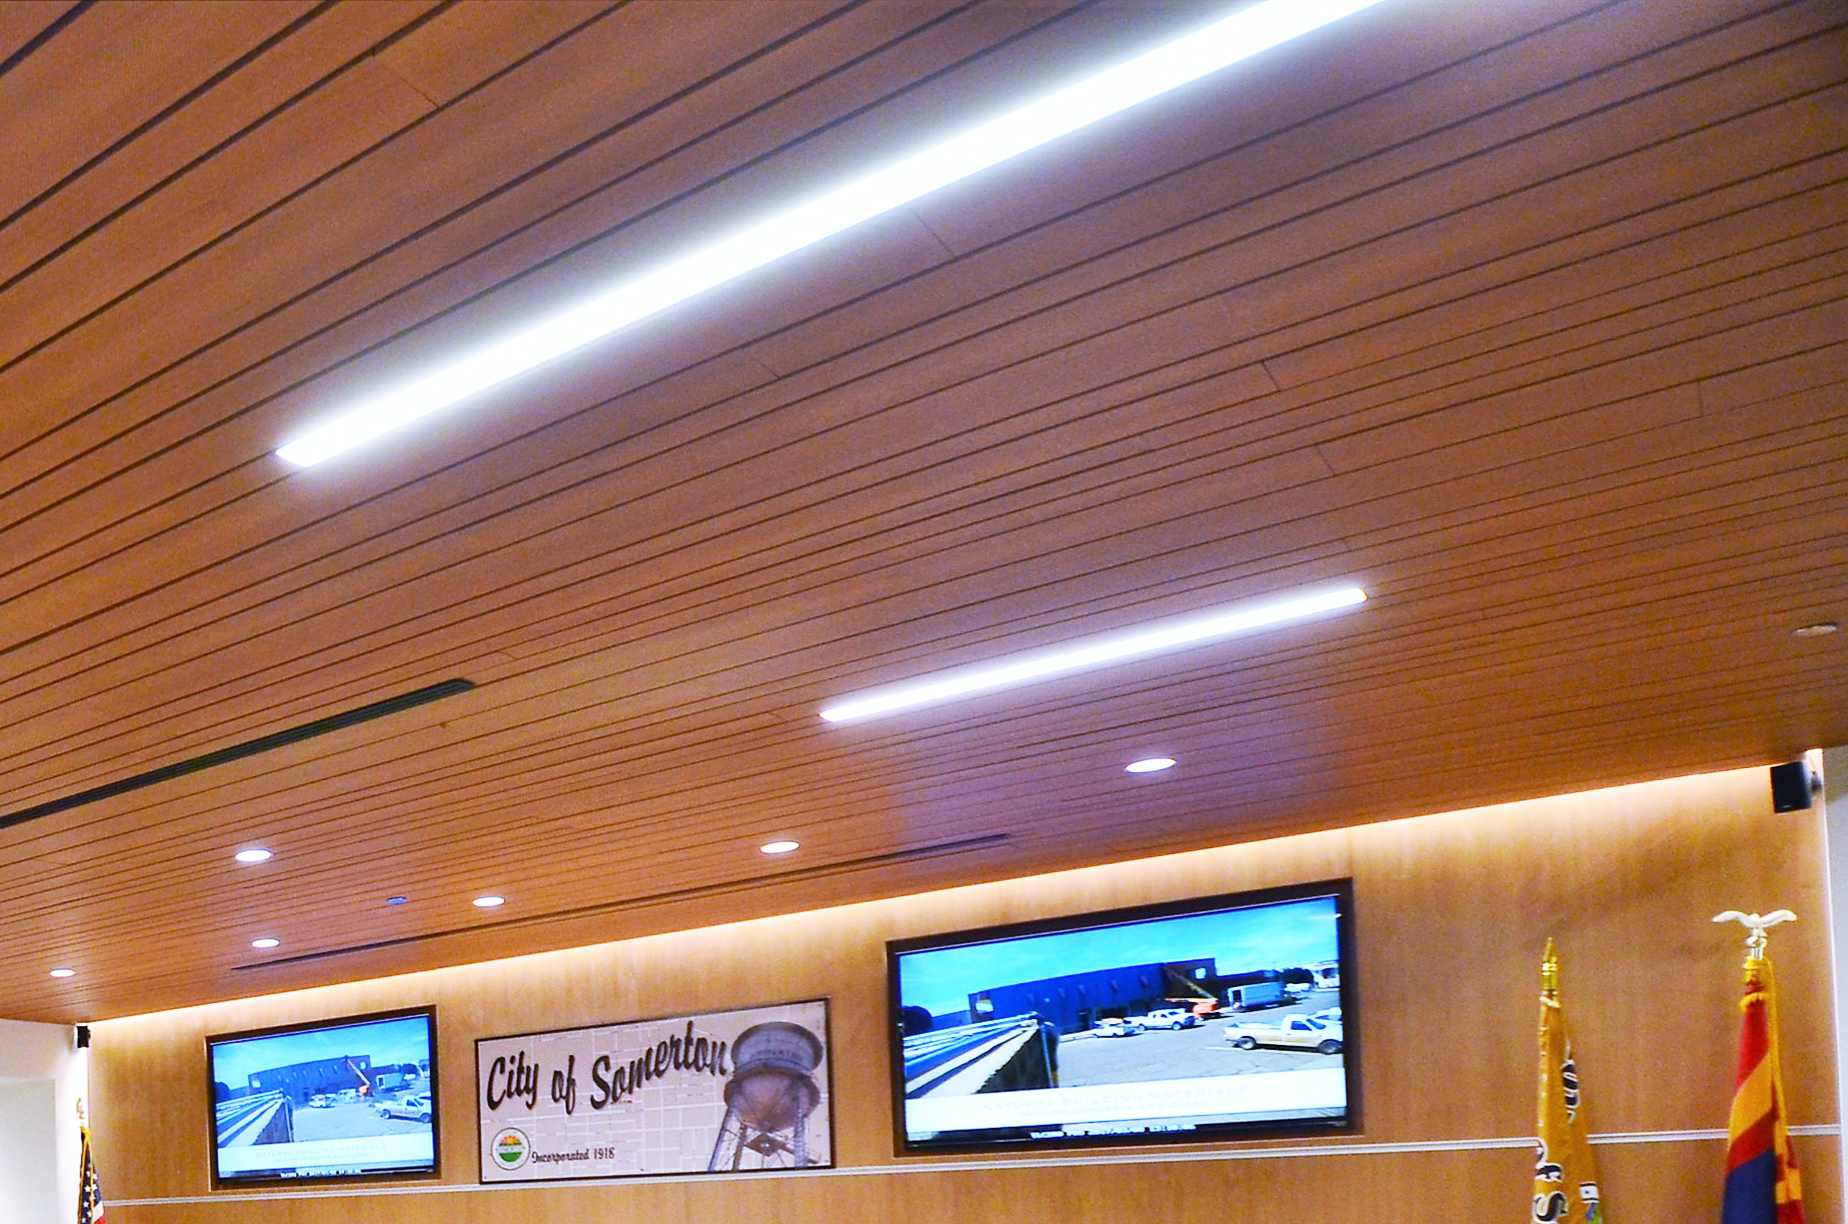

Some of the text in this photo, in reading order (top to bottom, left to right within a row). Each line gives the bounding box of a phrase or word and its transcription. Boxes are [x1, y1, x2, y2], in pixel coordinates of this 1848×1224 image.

[487, 1020, 728, 1115] City of Somerton
[983, 1085, 1248, 1112] NATURAL BUILDING MATERIALS
[531, 1147, 590, 1165] Incorporated
[594, 1147, 615, 1160] 1918
